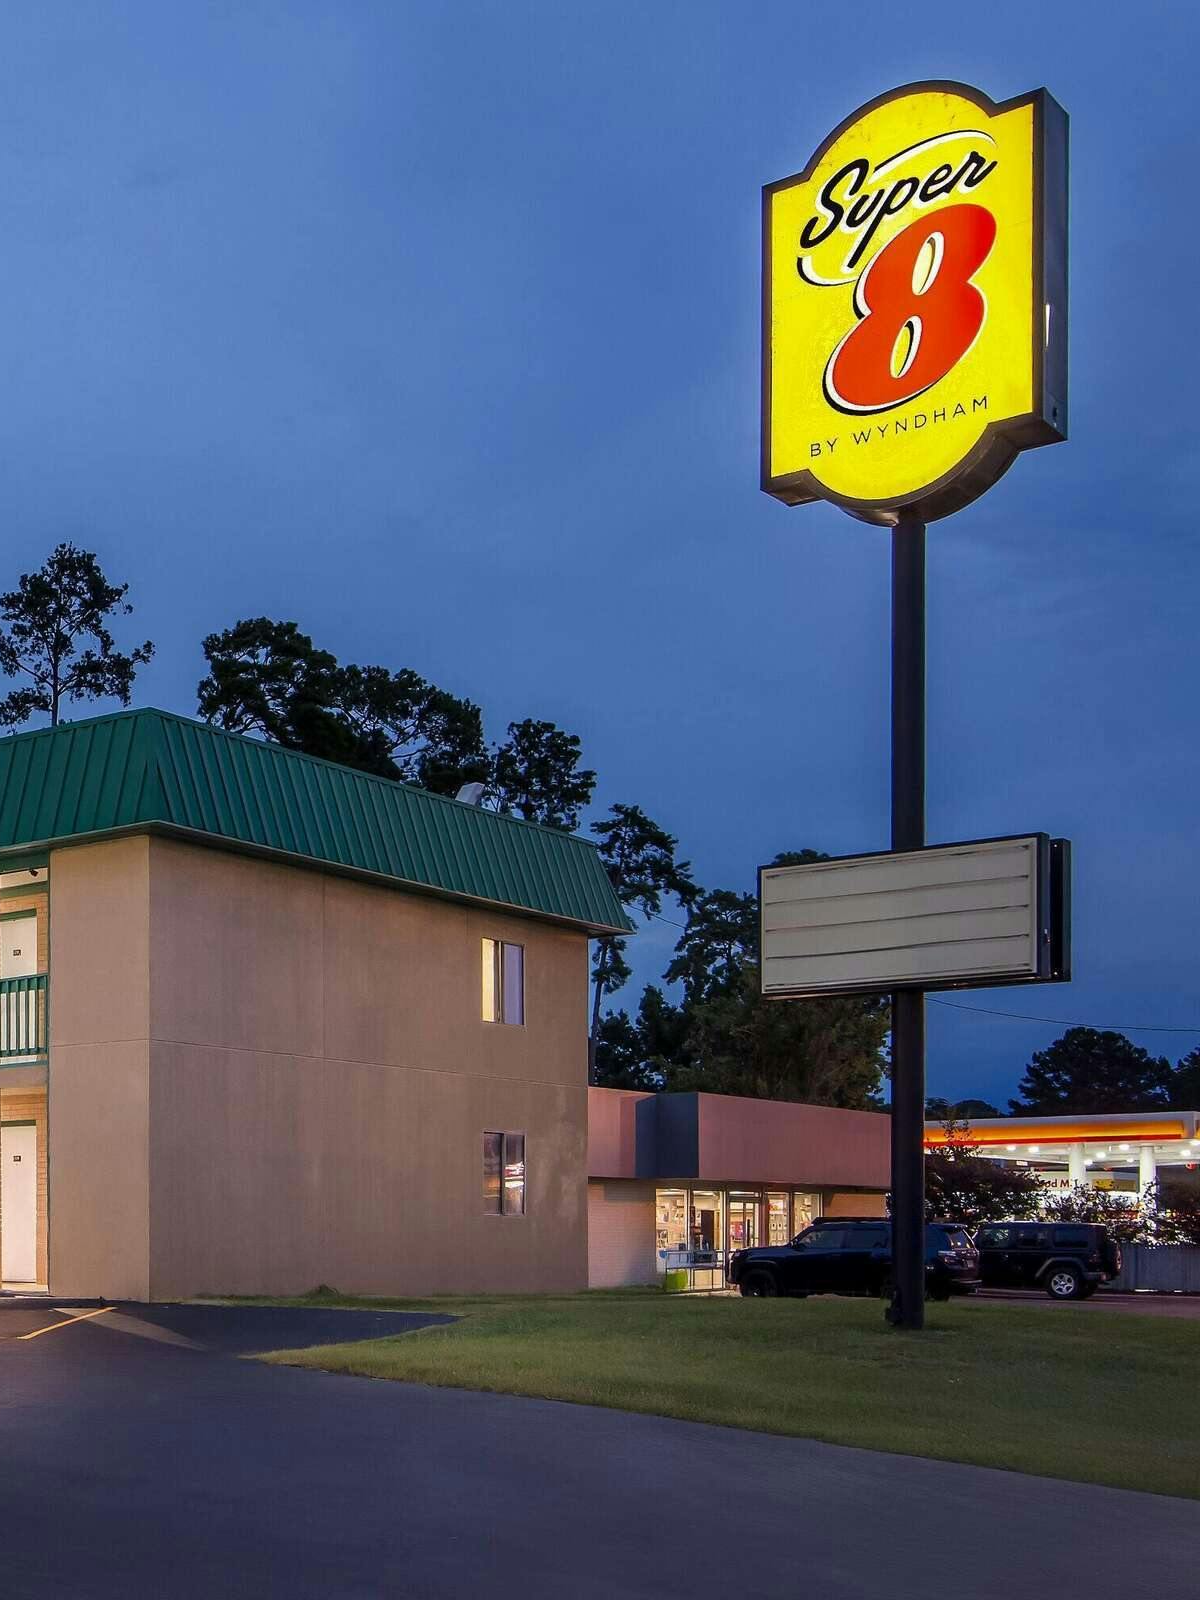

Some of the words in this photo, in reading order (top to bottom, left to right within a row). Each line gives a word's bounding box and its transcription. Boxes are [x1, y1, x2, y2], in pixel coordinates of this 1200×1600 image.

[800, 150, 998, 269] Super
[822, 202, 997, 416] 8
[810, 438, 838, 457] BY
[853, 395, 988, 445] WYNDHAM
